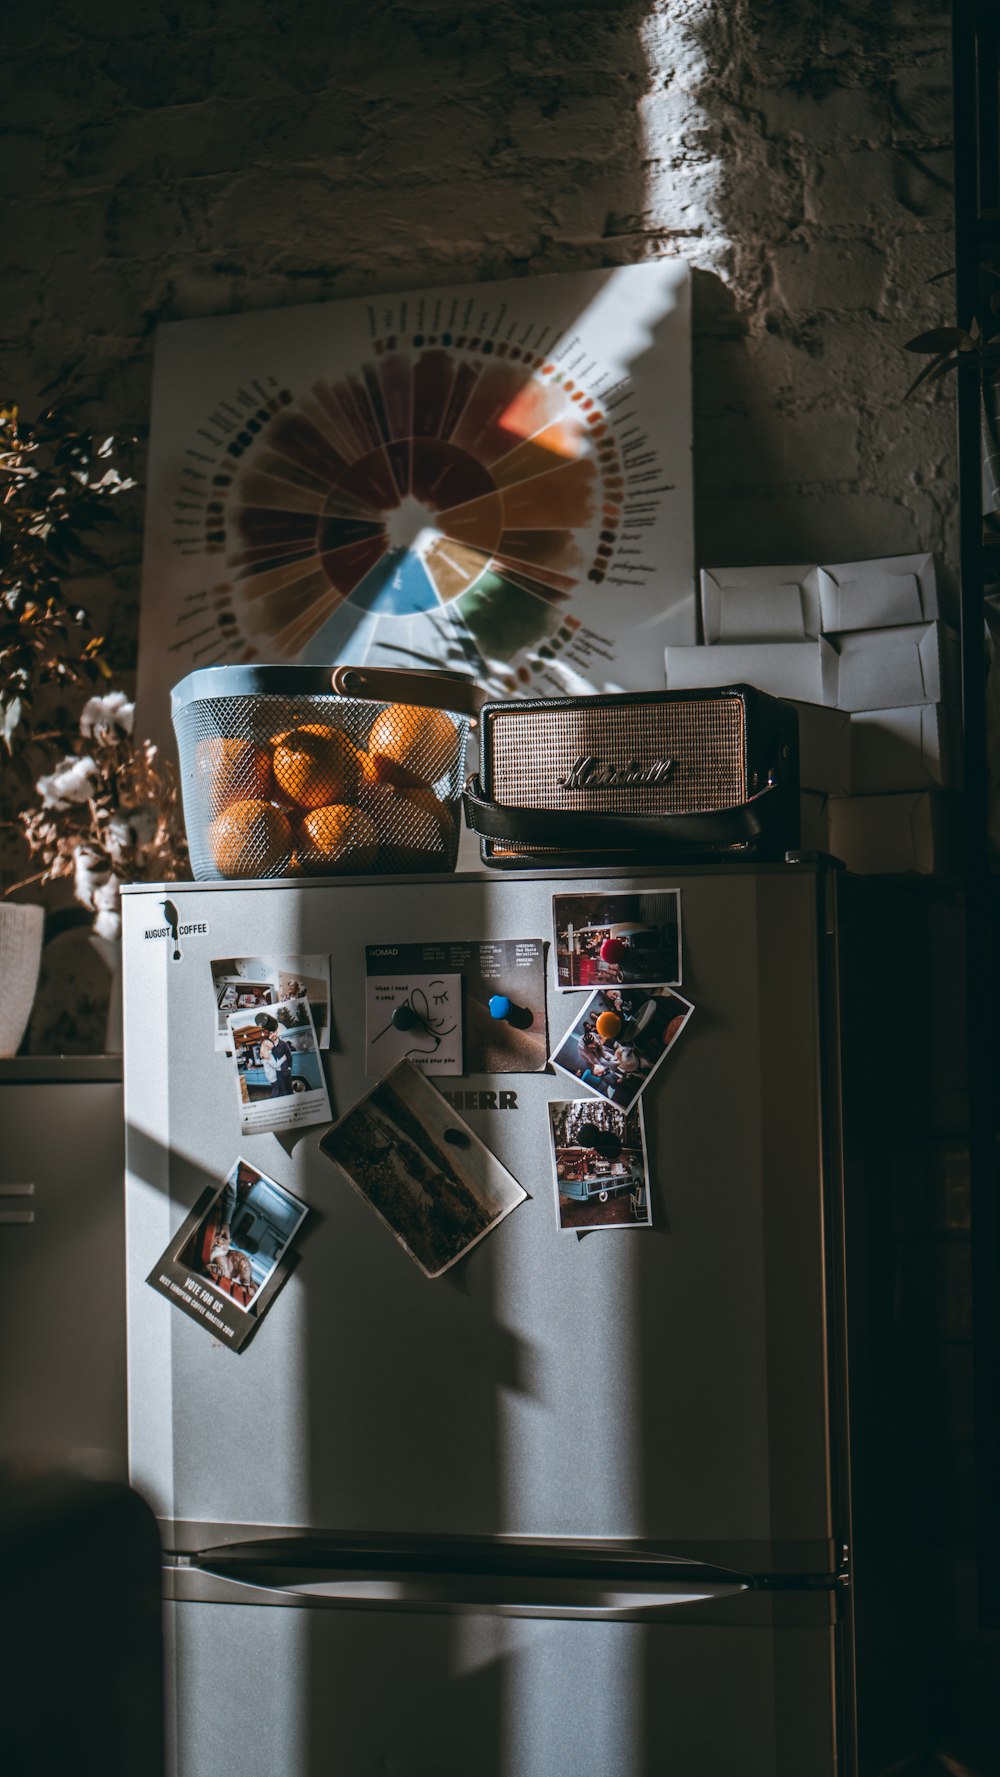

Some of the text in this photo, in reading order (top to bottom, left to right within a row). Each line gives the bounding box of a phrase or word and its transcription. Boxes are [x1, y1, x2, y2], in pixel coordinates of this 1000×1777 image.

[557, 755, 672, 789] Marshall
[145, 923, 207, 939] AUGUST COFFEE
[369, 948, 399, 957] NOMAD
[159, 1274, 172, 1287] BEST
[169, 1282, 192, 1304] EUROPEAN
[190, 1299, 207, 1315] COFFEE
[204, 1310, 225, 1329] ROASTER
[184, 1277, 224, 1313] VOTE FOR US
